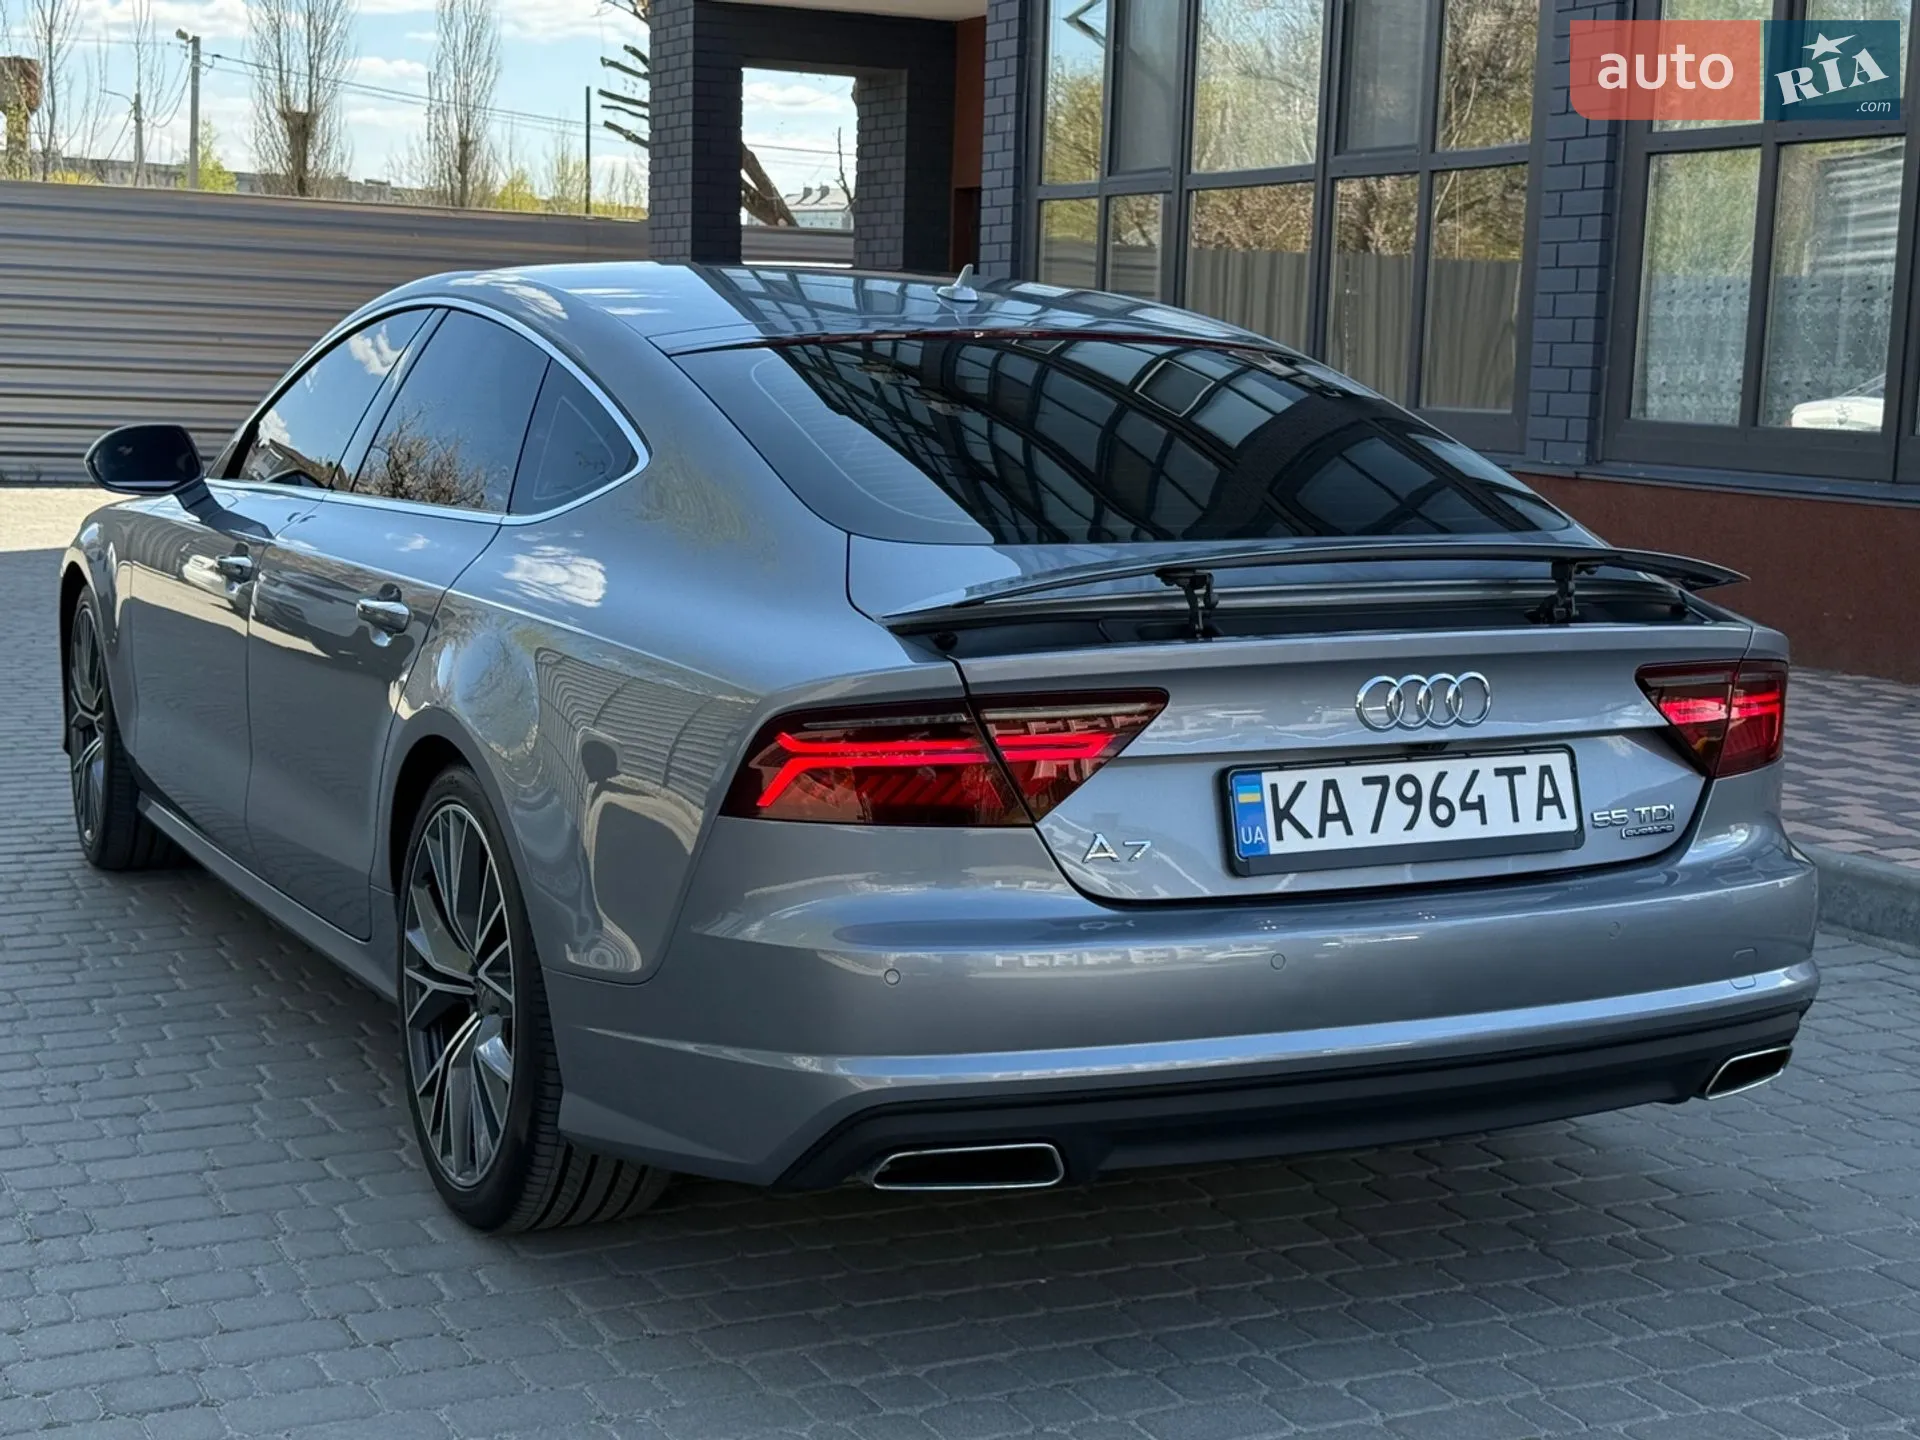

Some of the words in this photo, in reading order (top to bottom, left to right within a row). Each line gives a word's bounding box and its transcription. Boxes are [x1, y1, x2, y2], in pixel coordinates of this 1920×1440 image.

[1592, 808, 1630, 828] 55
[1633, 804, 1675, 824] TDI
[1241, 826, 1266, 844] UA
[1082, 833, 1151, 863] A7
